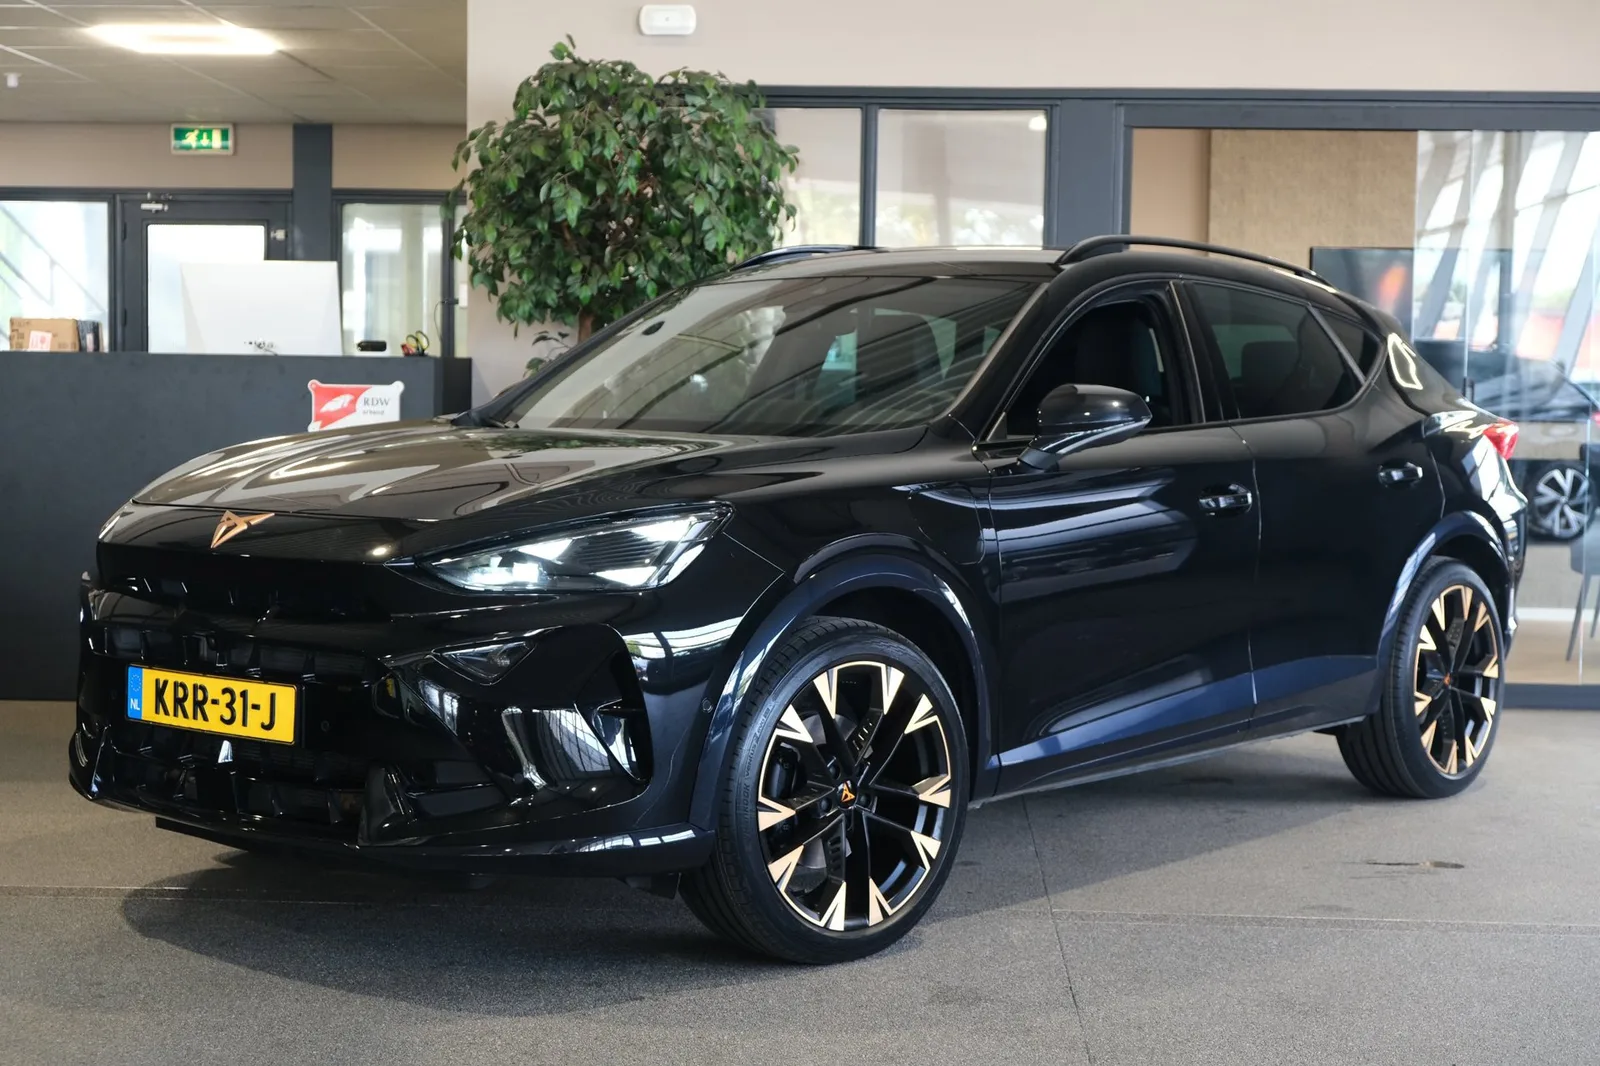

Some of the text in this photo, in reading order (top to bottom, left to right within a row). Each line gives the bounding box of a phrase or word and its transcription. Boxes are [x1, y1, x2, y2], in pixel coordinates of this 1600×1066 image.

[363, 397, 390, 406] RDW
[130, 698, 141, 711] NL
[154, 678, 277, 731] KRR-31-J
